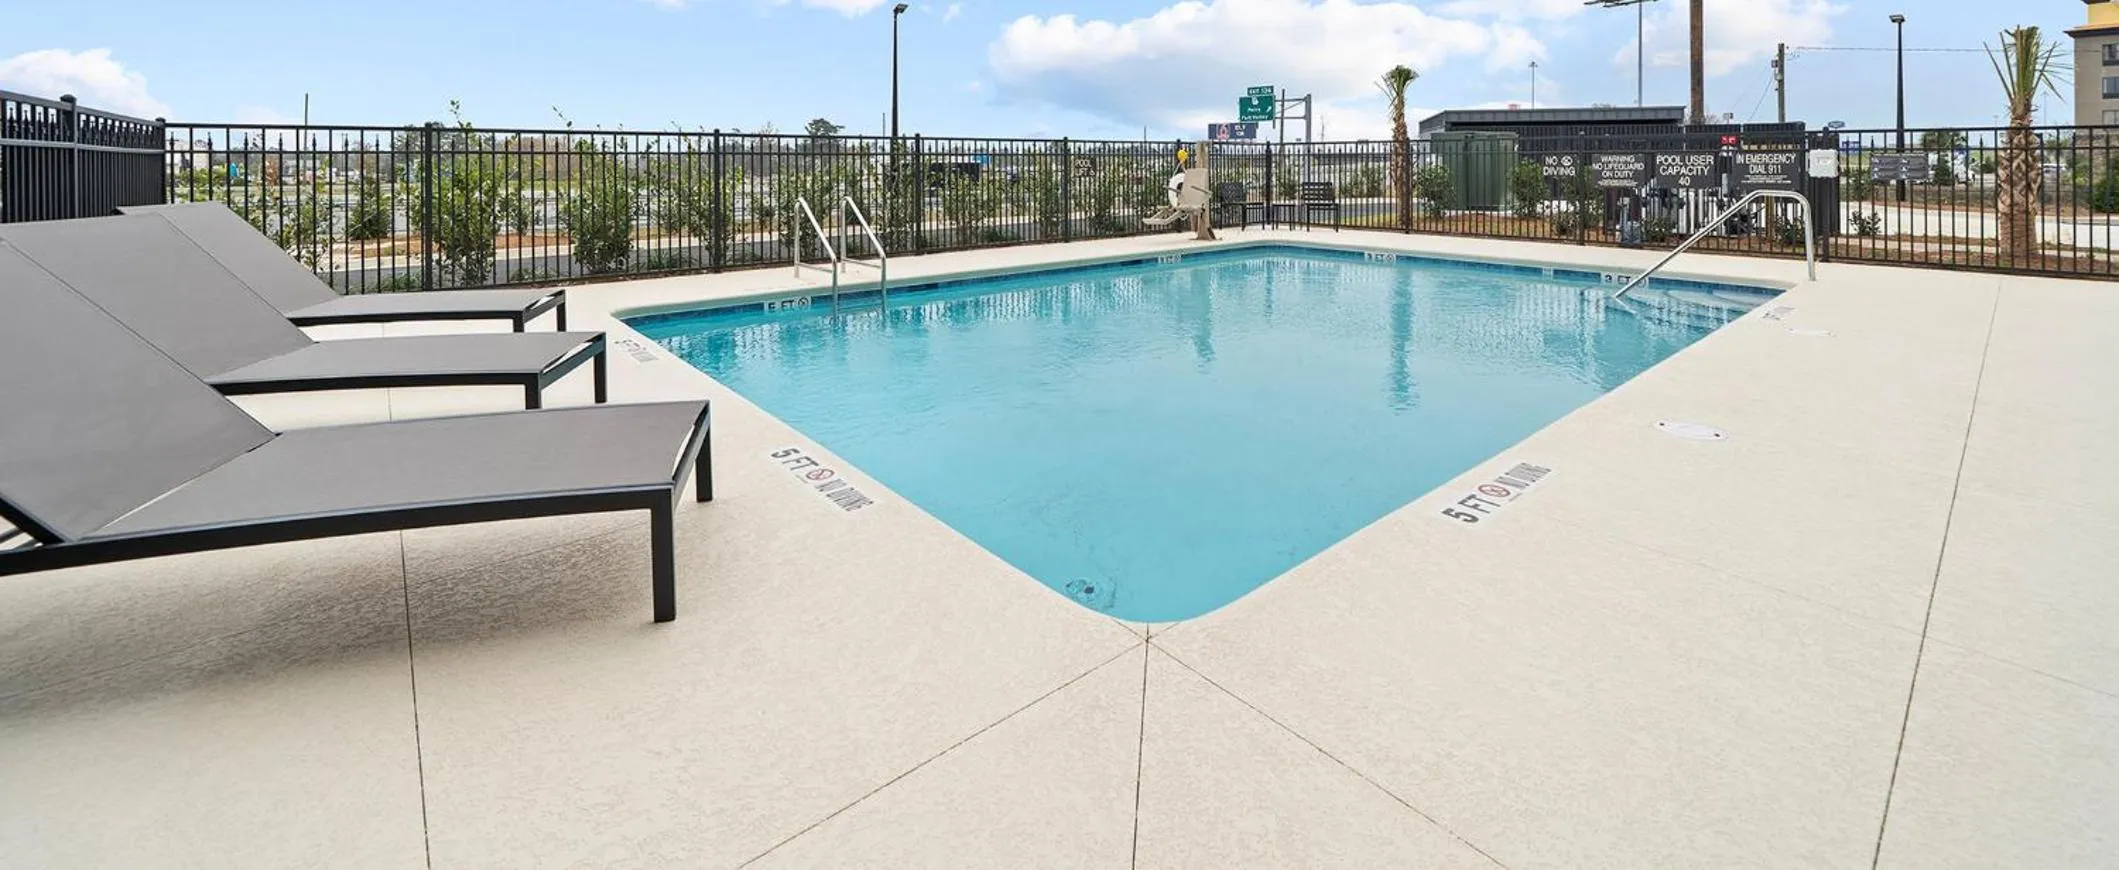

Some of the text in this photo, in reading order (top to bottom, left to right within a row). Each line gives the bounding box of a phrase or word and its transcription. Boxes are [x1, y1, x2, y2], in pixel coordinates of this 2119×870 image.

[1545, 155, 1558, 166] NO
[1600, 155, 1635, 163] WARNING
[1656, 154, 1715, 165] POOL USER
[1736, 153, 1796, 164] IN EMERGENCY
[1543, 166, 1576, 176] DIVING
[1592, 162, 1645, 170] NO LIFEGUARD
[1659, 165, 1710, 176] CAPACITY
[1749, 165, 1781, 174] DIAL 911
[1601, 170, 1634, 178] ON DUTY
[1678, 176, 1691, 187] 40
[770, 448, 801, 459] 5
[782, 456, 820, 471] FT
[1504, 462, 1552, 483] DIVING
[814, 478, 847, 492] NO
[1493, 475, 1531, 489] NO
[826, 486, 874, 512] DIVING
[1457, 493, 1501, 514] FT
[1440, 508, 1480, 523] 5
